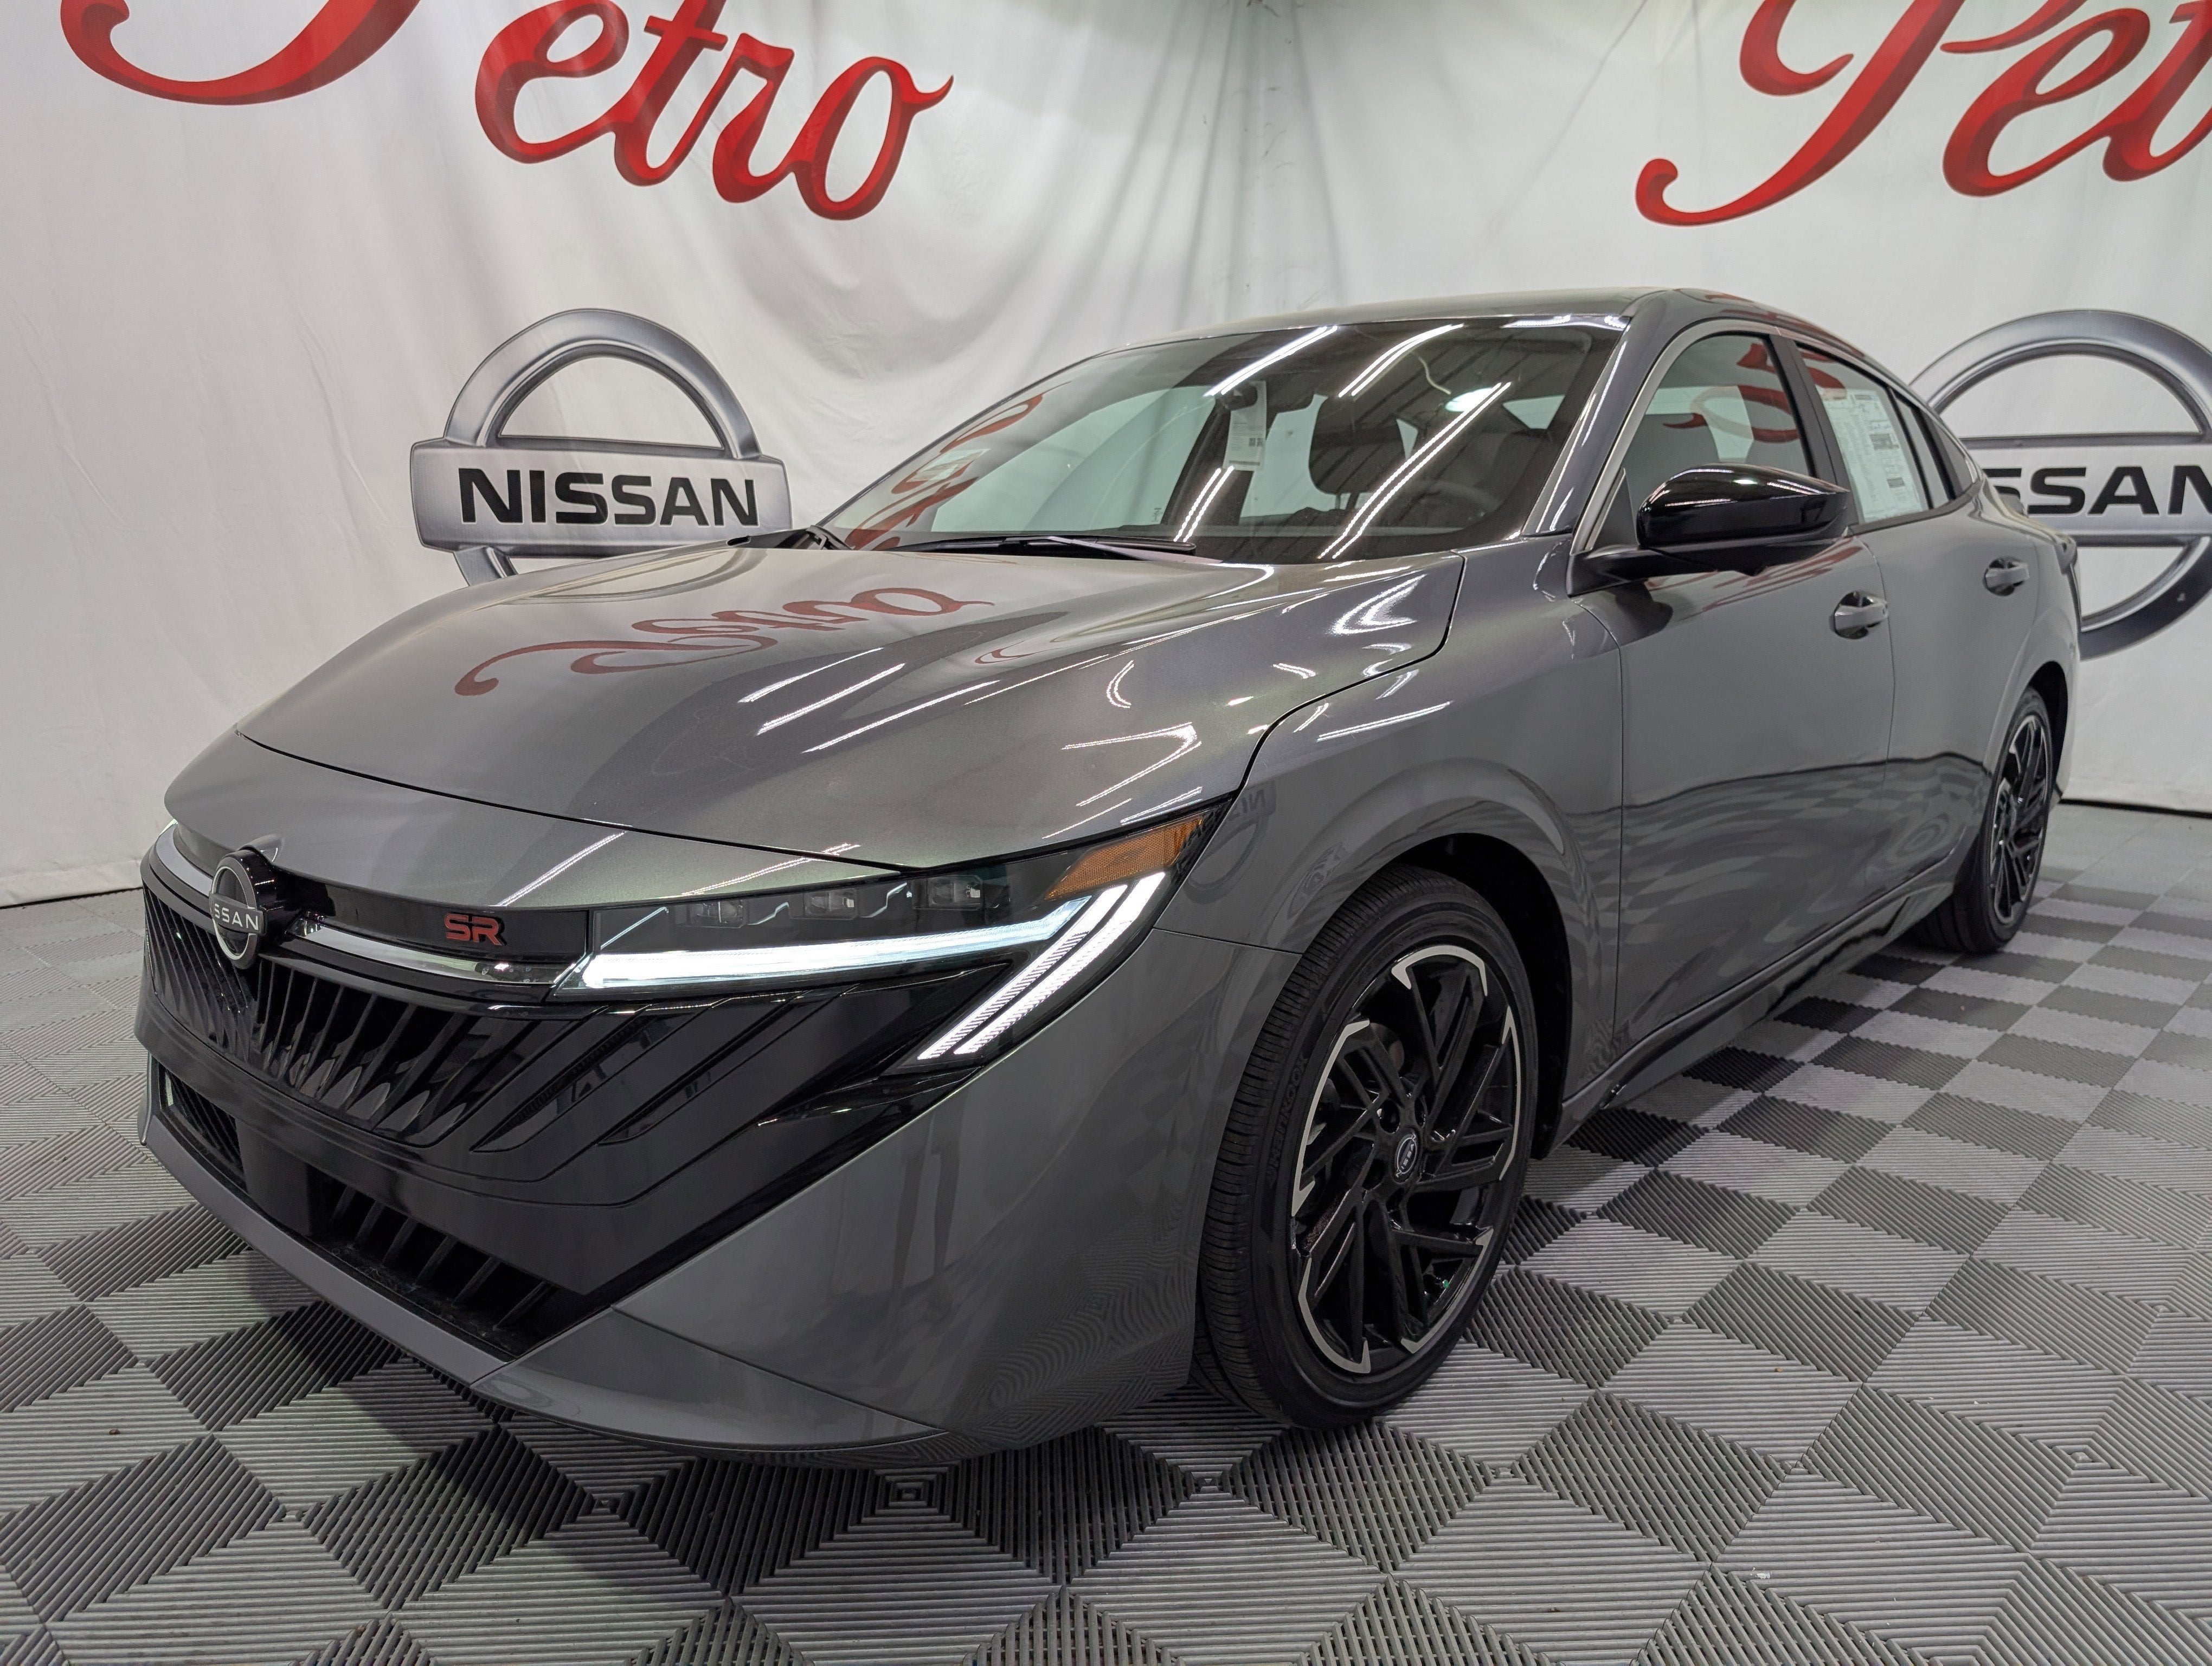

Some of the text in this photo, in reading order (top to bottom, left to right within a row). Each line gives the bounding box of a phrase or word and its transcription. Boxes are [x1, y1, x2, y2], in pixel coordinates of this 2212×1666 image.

[458, 467, 760, 527] NISSAN
[1982, 465, 2212, 516] SAN
[214, 903, 259, 931] SSAN
[445, 913, 503, 946] SR
